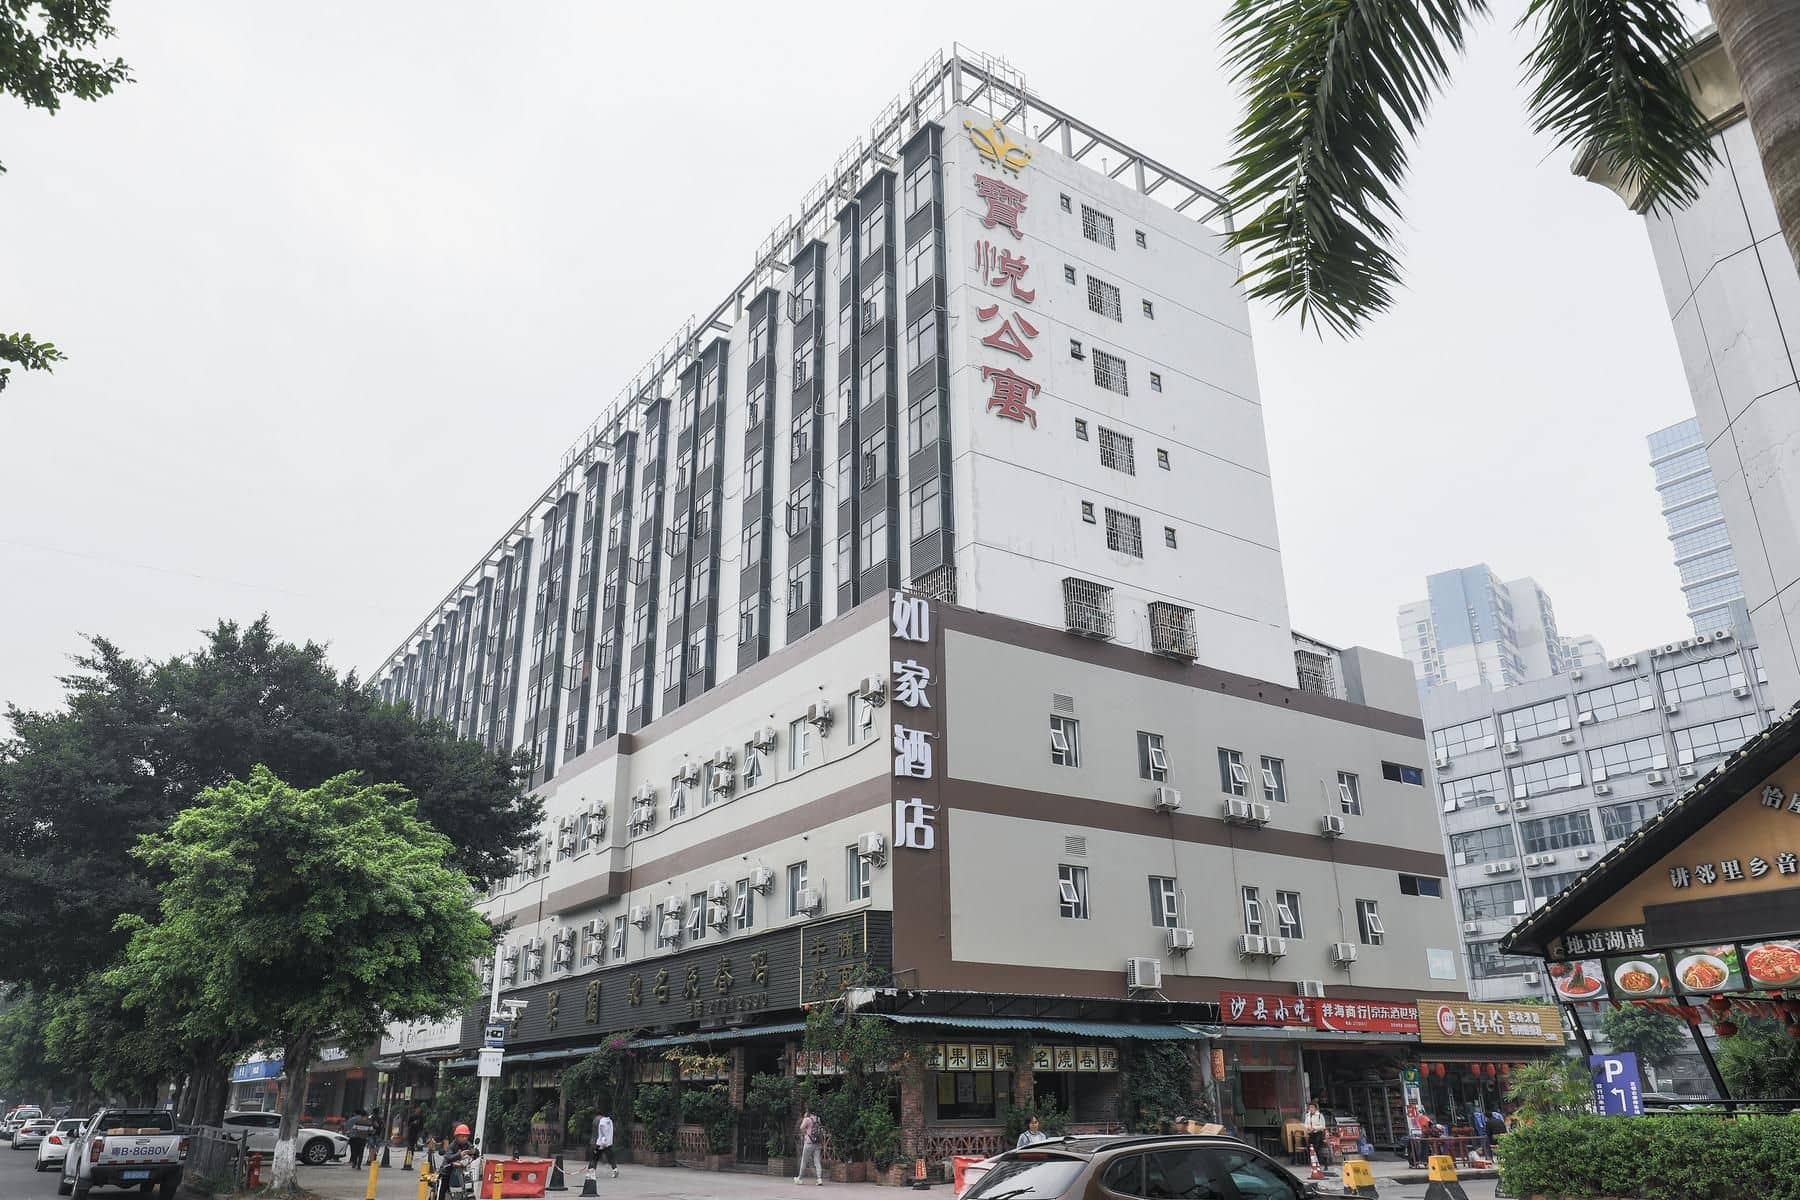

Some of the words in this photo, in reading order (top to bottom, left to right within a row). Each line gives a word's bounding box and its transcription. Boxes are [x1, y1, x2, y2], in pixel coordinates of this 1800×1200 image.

[891, 591, 935, 850] 如家酒店
[1670, 853, 1799, 889] 讲邻里乡音
[1566, 928, 1645, 956] 地道湖南
[1231, 995, 1310, 1023] 沙县小吃
[1604, 1060, 1623, 1083] P
